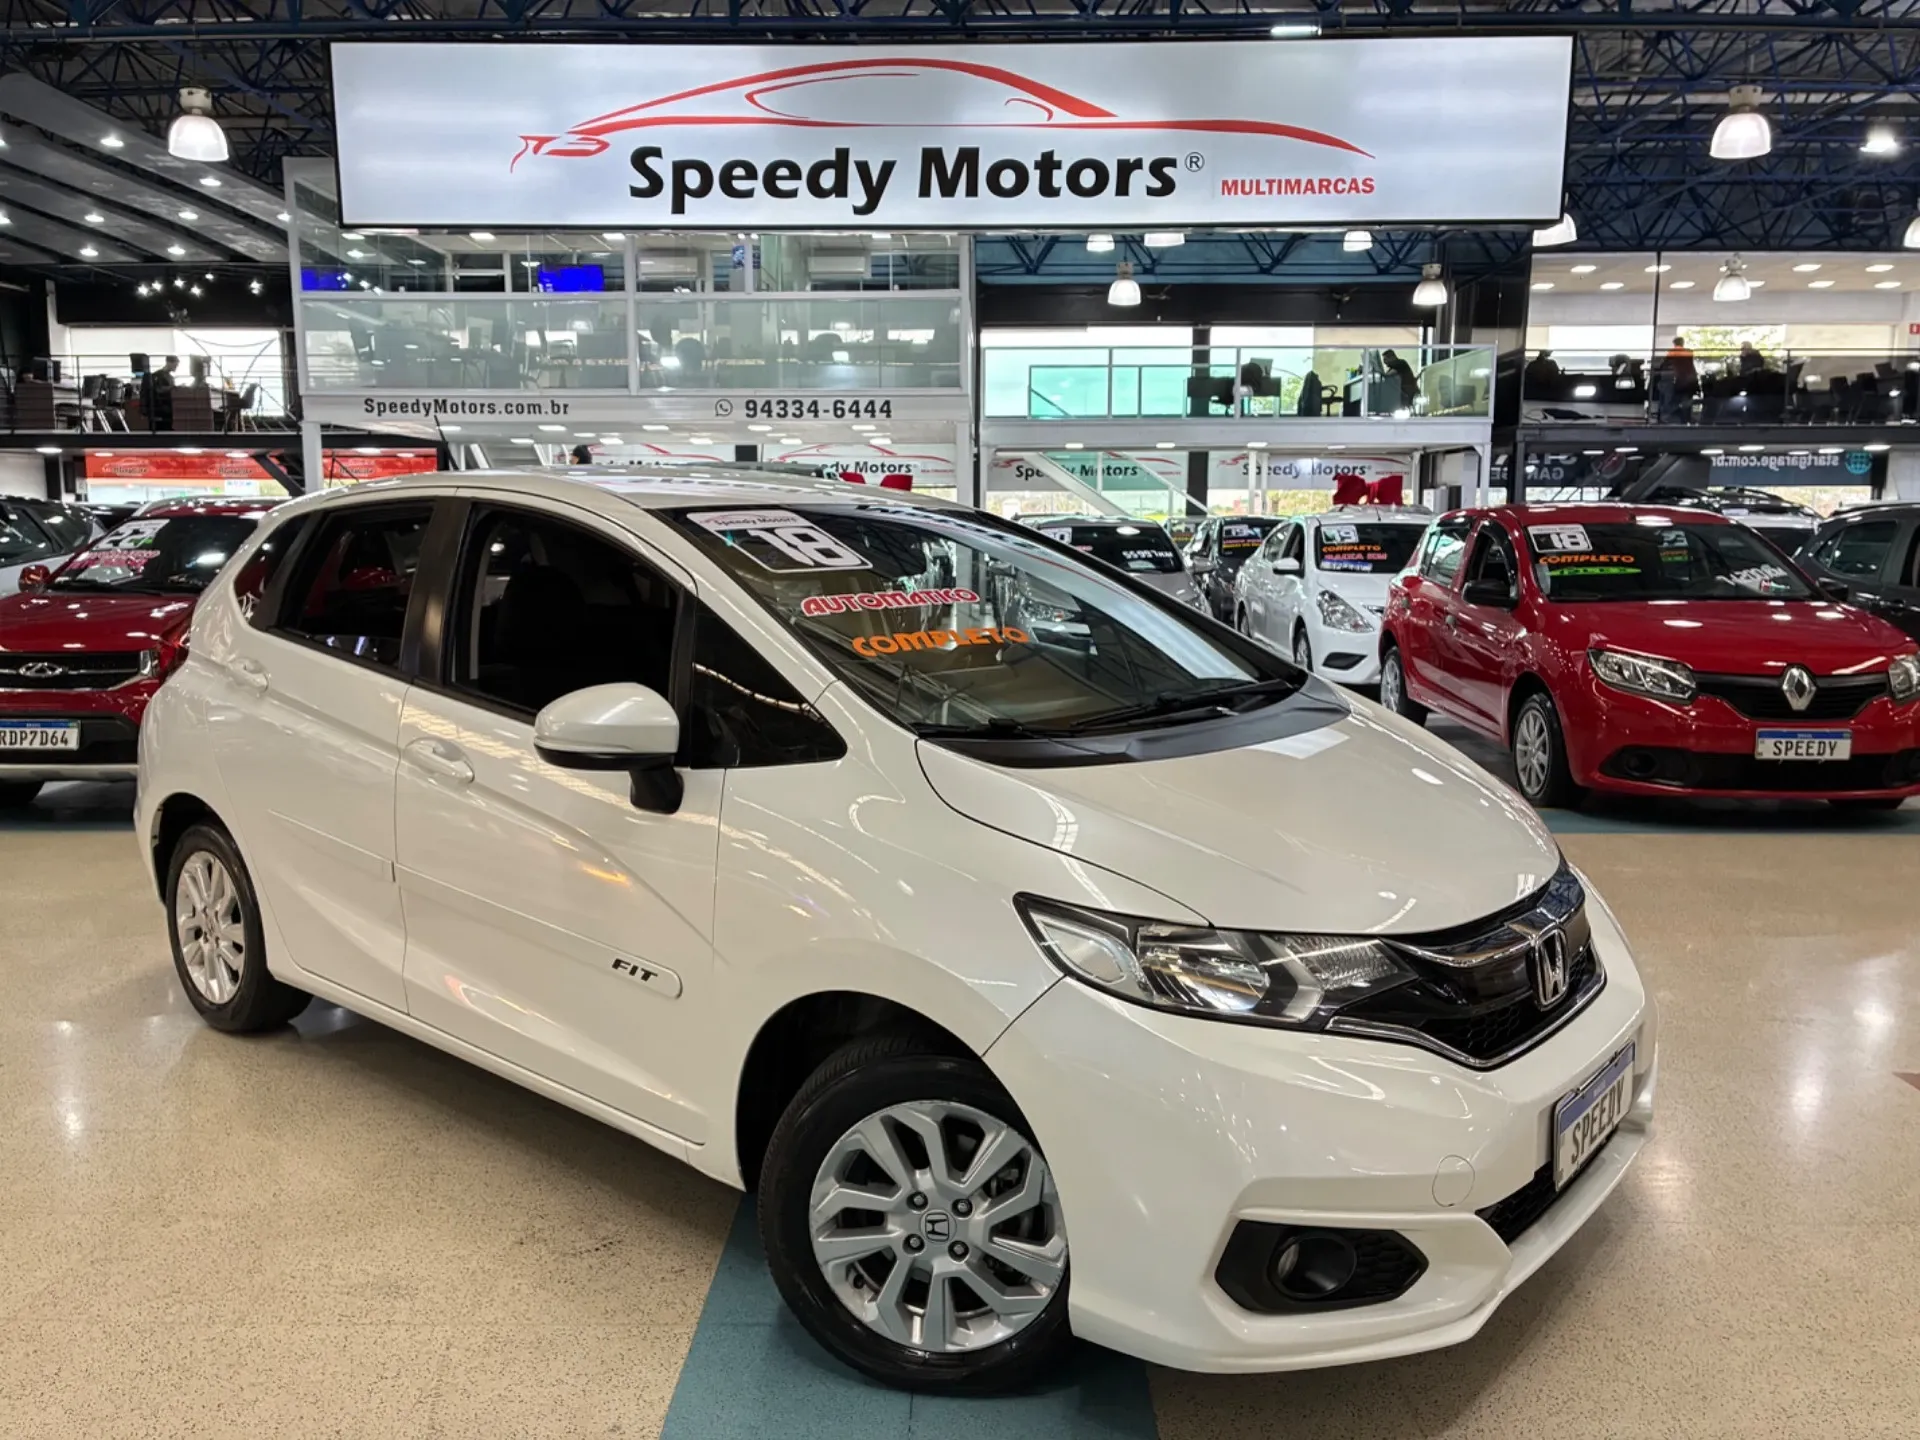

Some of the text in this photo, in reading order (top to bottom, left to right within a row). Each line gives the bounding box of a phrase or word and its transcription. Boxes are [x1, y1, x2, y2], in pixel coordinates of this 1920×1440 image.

[629, 146, 897, 216] Speedy
[1221, 177, 1375, 195] MULTIMARCAS
[364, 398, 569, 416] SpeedyMotors.com.br
[745, 399, 892, 418] 94334-6444
[747, 527, 862, 566] 18
[1322, 544, 1381, 553] COMPLETO
[1550, 532, 1590, 550] 18
[1540, 554, 1635, 566] COMPLETO
[801, 587, 980, 616] AUTOMATICO
[852, 627, 1029, 657] COMPLETO
[0, 730, 68, 746] RDP7D64
[1772, 740, 1838, 757] SPEEDY
[611, 958, 659, 982] FIT
[1571, 1075, 1625, 1165] SPEEDY
